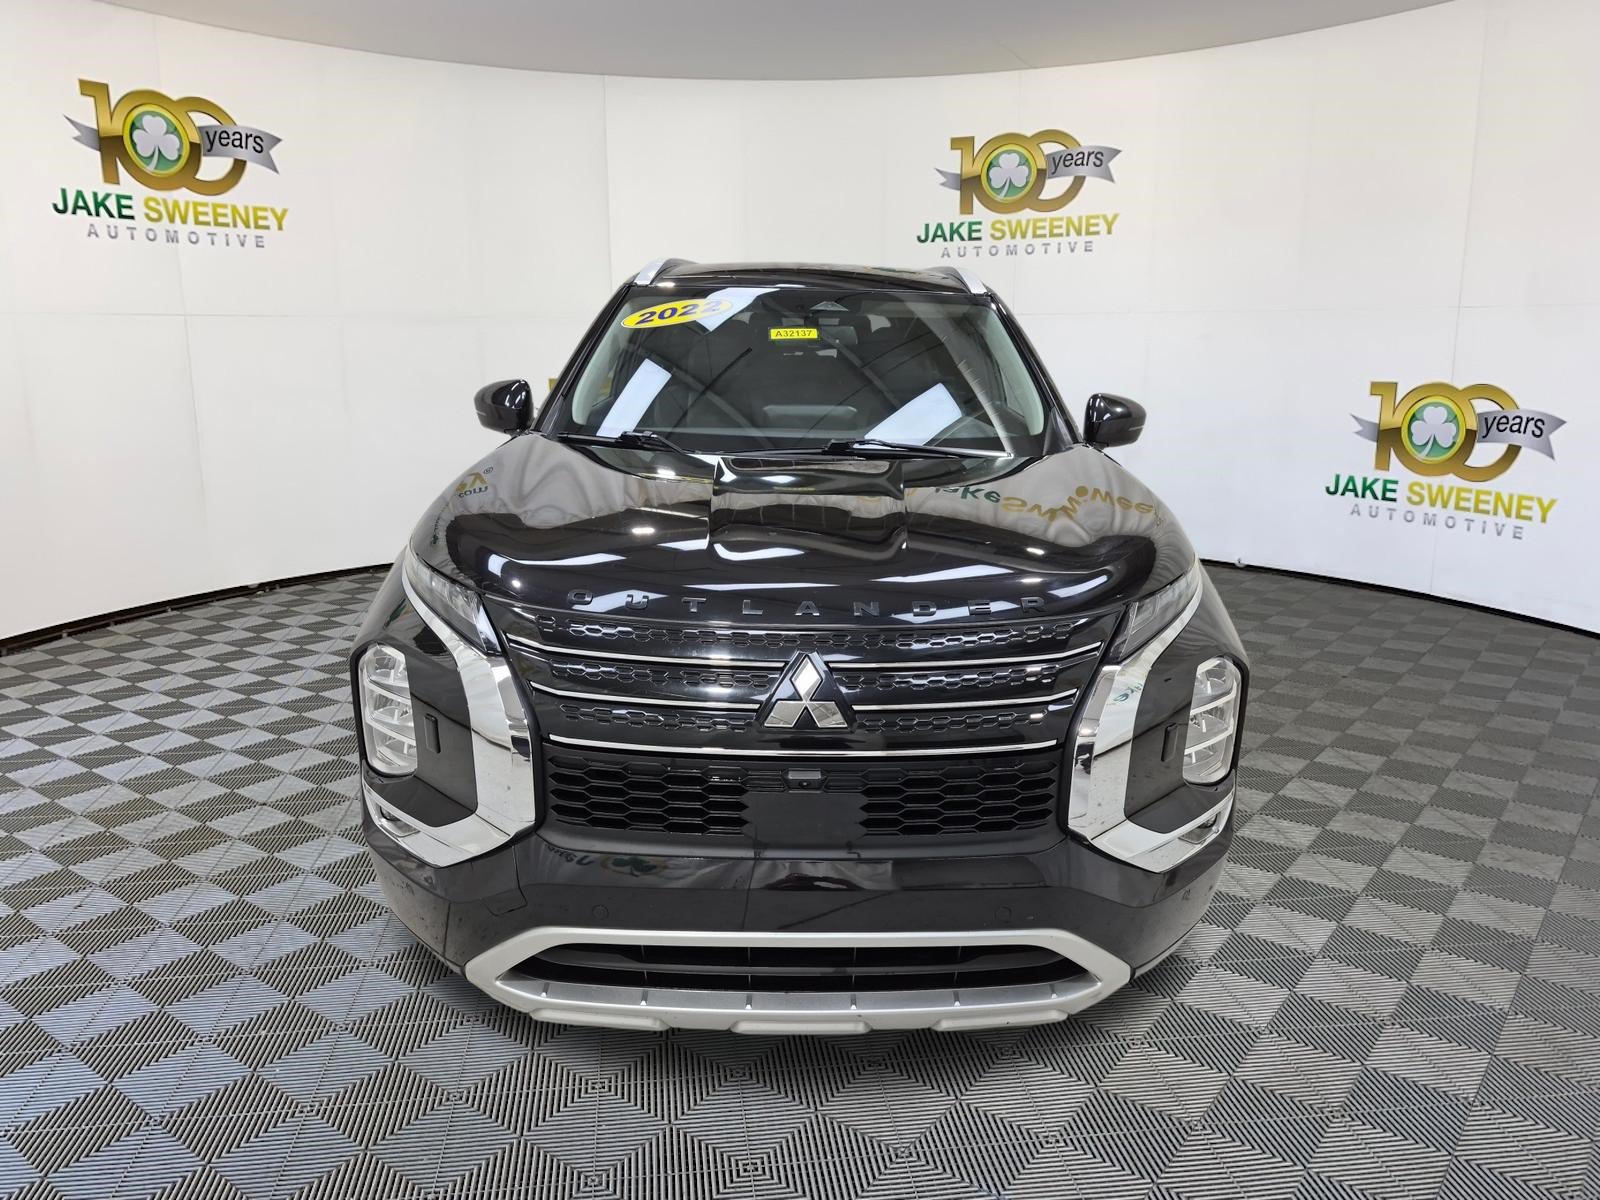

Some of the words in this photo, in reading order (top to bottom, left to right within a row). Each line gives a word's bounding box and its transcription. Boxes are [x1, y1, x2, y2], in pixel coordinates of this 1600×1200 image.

[78, 78, 247, 196] 100
[205, 129, 265, 154] years
[950, 128, 1087, 215] 100
[1051, 150, 1104, 175] years
[52, 187, 136, 221] JAKE
[143, 196, 289, 231] SWEENEY
[87, 223, 265, 249] AUTOMOTIVE
[916, 220, 983, 243] JAKE
[990, 213, 1120, 241] SWEENEY
[941, 241, 1094, 259] AUTOMOTIVE
[634, 300, 724, 326] 2022
[774, 329, 813, 338] A32137
[1370, 381, 1522, 482] 100
[1481, 413, 1546, 439] years
[1325, 473, 1399, 502] JAKE
[1406, 481, 1558, 524] SWEENEY
[1350, 503, 1525, 541] AUTOMOTIVE
[567, 588, 1046, 617] OUTLANDER
